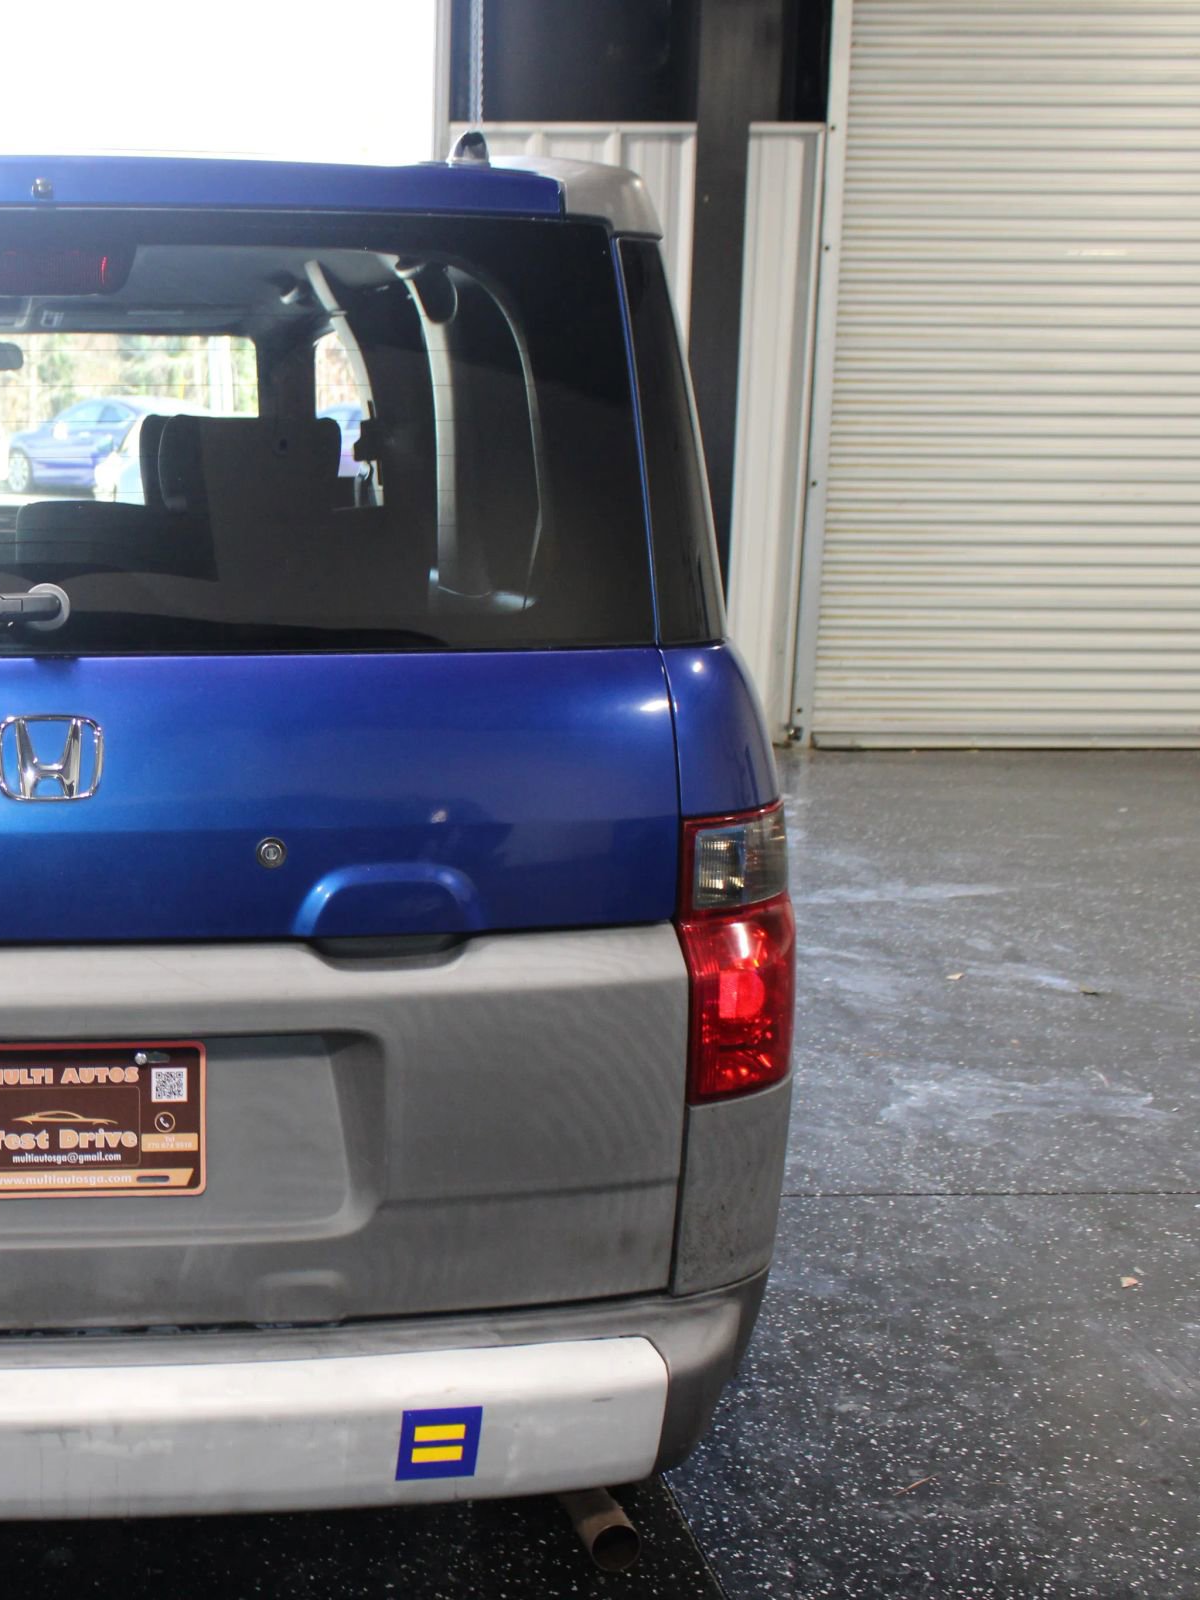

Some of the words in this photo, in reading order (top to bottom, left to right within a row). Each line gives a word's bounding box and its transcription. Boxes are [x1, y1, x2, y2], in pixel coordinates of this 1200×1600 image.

[60, 1066, 139, 1084] AUTOS
[59, 1128, 138, 1149] Drive
[12, 1152, 121, 1164] multiautosga@gmail.com
